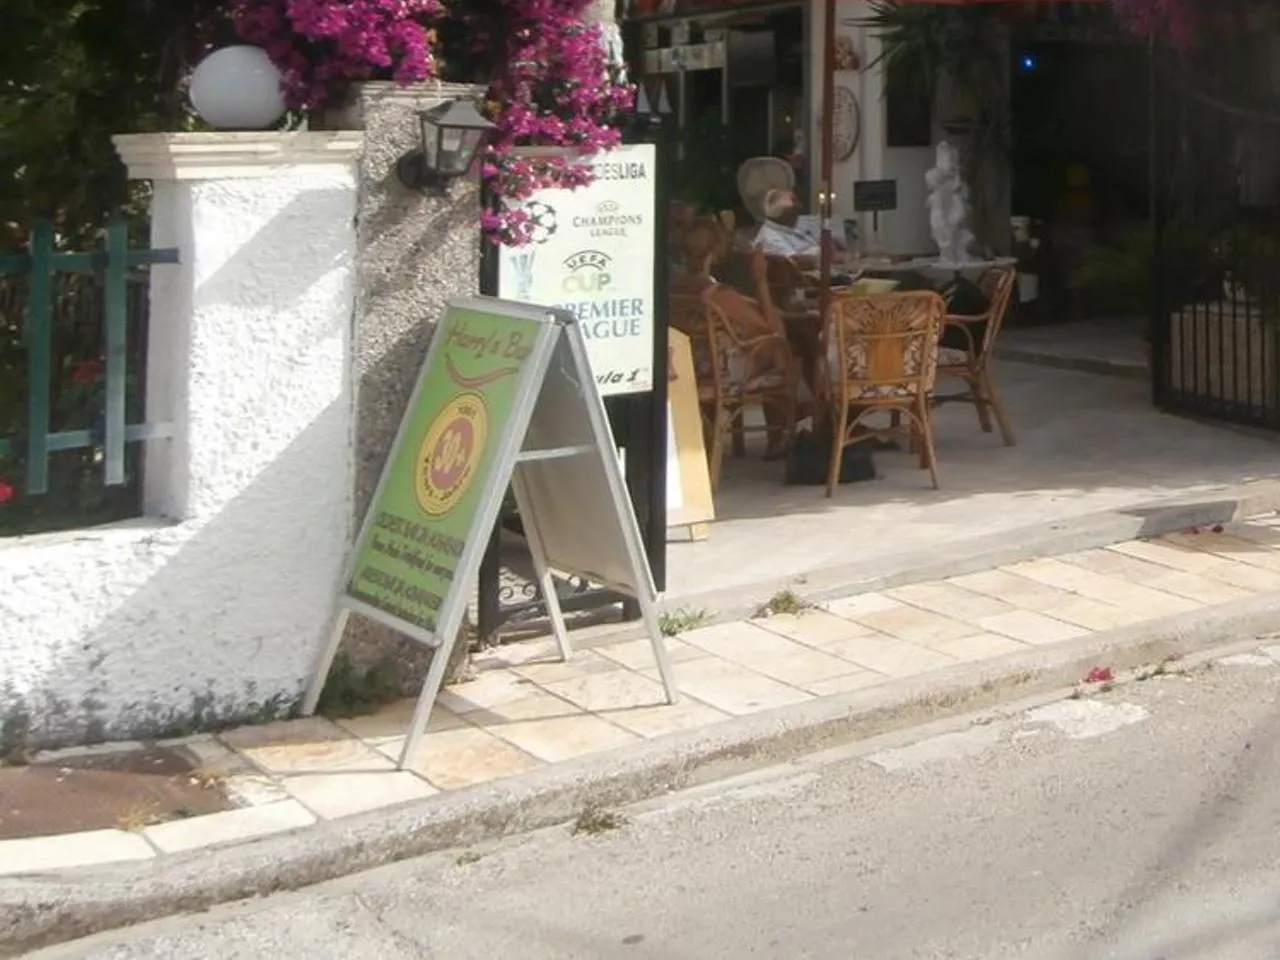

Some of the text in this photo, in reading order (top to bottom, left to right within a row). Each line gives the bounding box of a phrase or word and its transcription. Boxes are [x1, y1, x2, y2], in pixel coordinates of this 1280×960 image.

[573, 214, 643, 228] CHAMPIONS
[567, 254, 607, 270] UEFA
[562, 272, 612, 294] CUP
